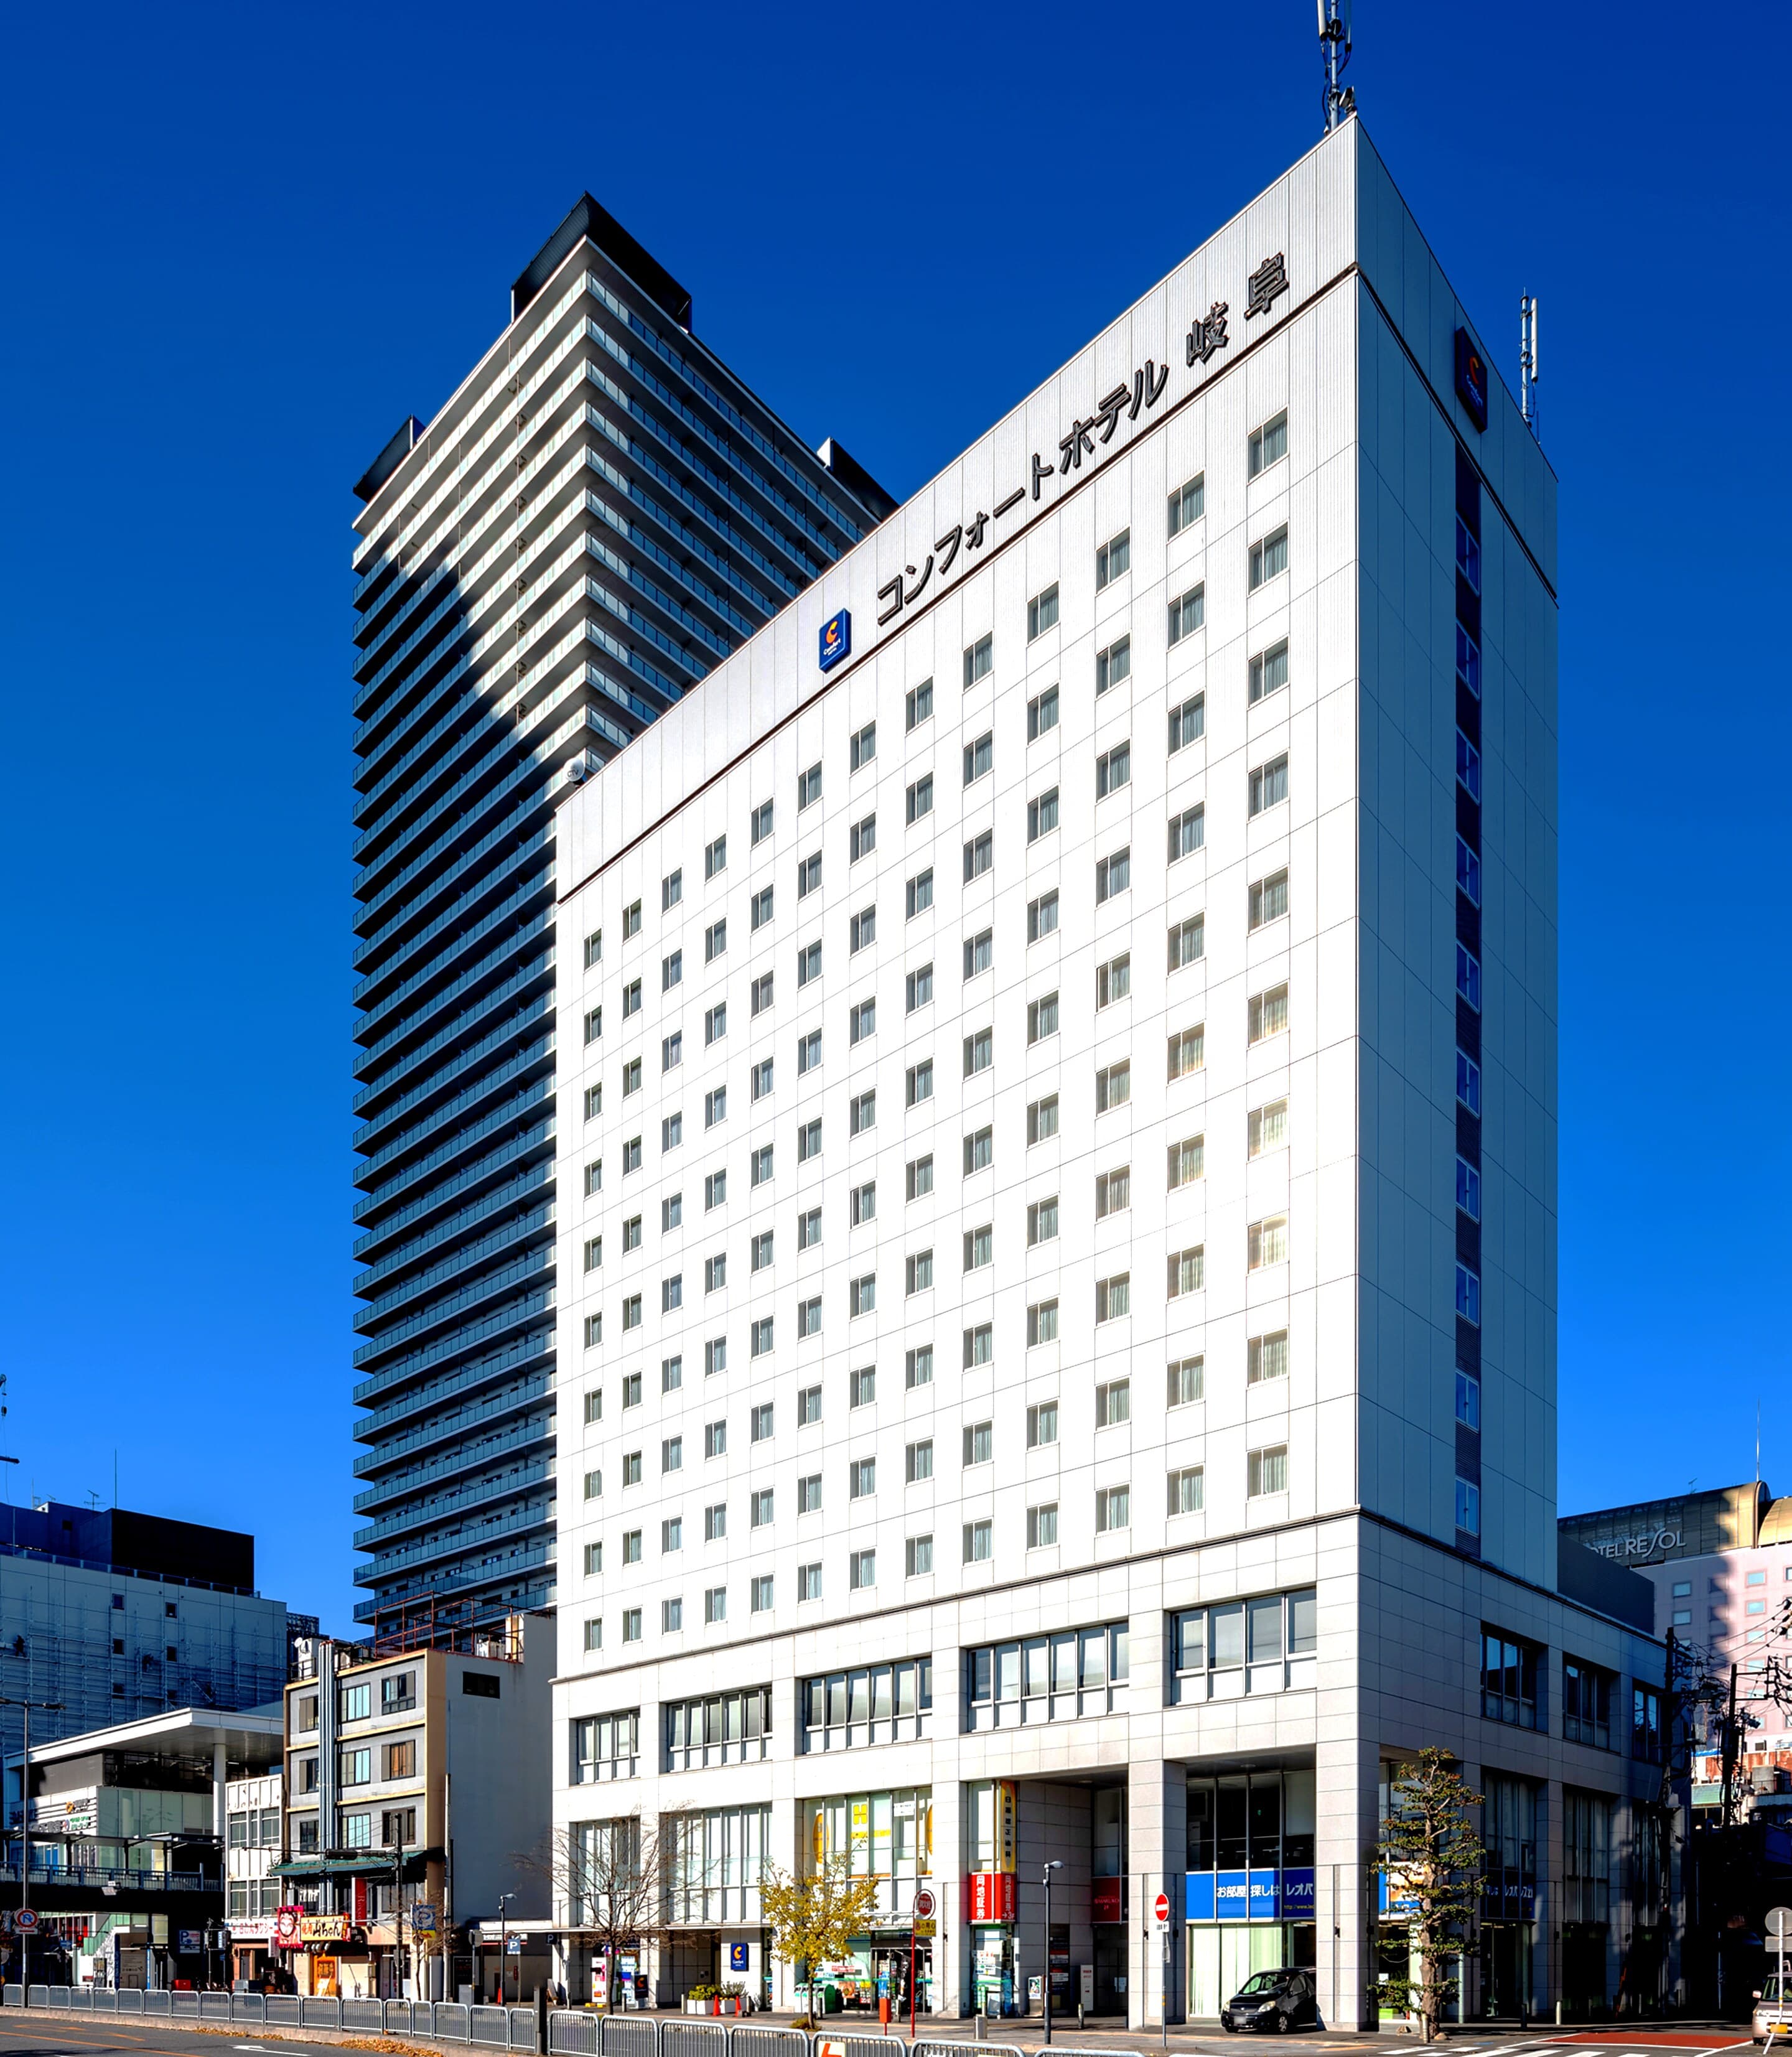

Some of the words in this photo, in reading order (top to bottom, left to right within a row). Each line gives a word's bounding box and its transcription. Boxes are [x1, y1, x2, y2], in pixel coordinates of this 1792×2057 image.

[877, 359, 1170, 627] コンフォートホテル
[1186, 251, 1290, 368] 岐阜
[1625, 1528, 1687, 1558] RESOL
[976, 1875, 985, 1919] 岡地証券
[1286, 1883, 1314, 1896] レオパ
[510, 1941, 518, 1949] P
[548, 1934, 553, 1943] P
